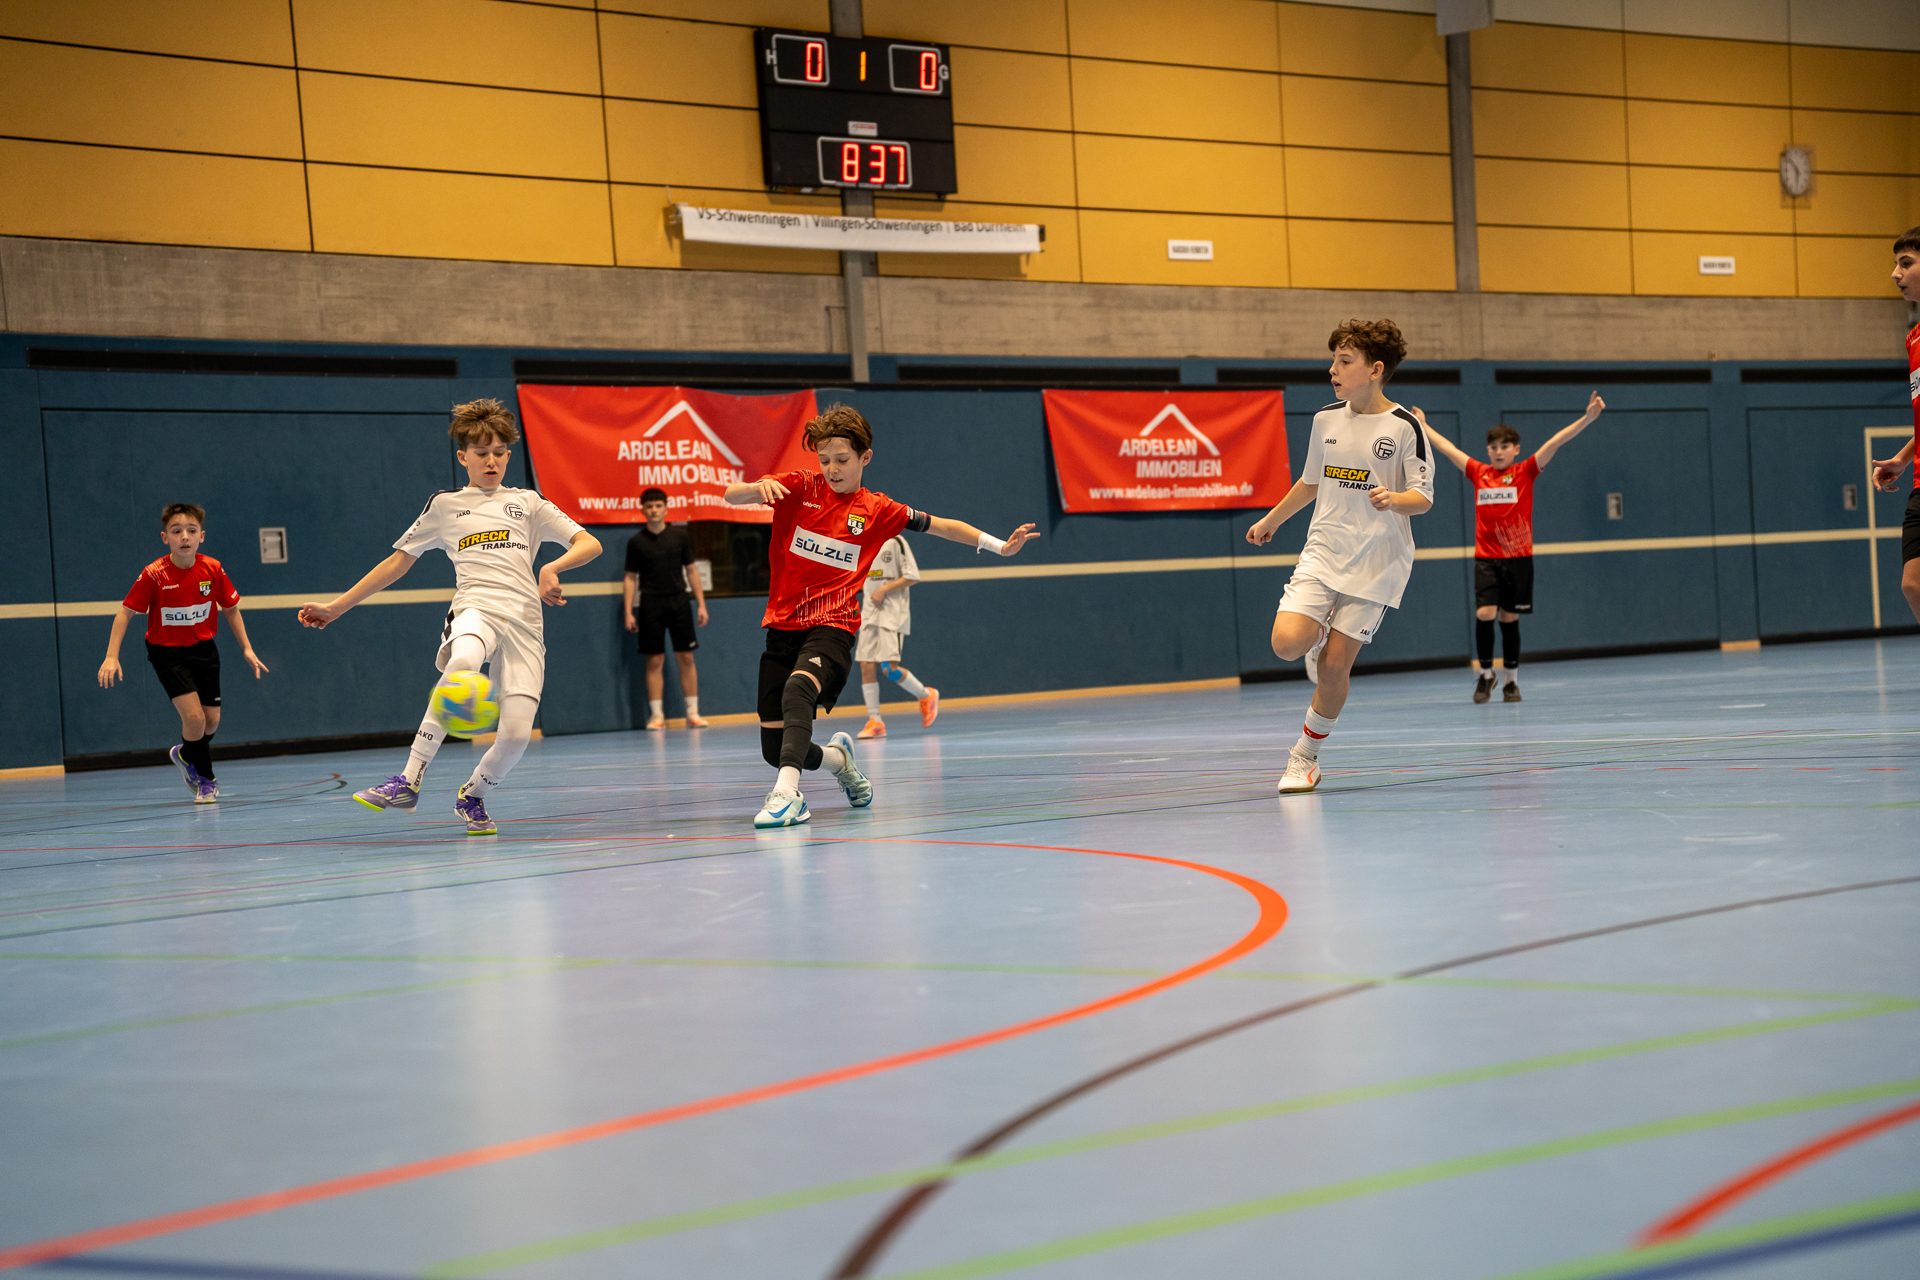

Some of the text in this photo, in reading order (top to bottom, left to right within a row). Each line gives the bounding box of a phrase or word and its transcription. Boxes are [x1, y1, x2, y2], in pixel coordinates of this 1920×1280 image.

[766, 49, 777, 65] H
[806, 43, 823, 81] 0
[920, 52, 937, 90] 0
[938, 65, 949, 80] G
[617, 439, 712, 461] ARDELEAN
[1118, 438, 1198, 457] ARDELEAN
[638, 462, 744, 487] IMMOBILIEN
[1136, 459, 1222, 478] IMMOBILIEN
[1325, 466, 1368, 481] STRECK
[1089, 481, 1253, 499] www.ardelean-immobilien.de
[1338, 480, 1389, 493] TRANSP
[1480, 492, 1514, 500] SÜLZLE
[456, 510, 471, 519] JAKO
[460, 530, 509, 550] STRECK
[481, 541, 529, 552] TRANSPORT
[795, 537, 854, 563] SÜLZLE
[417, 730, 434, 741] AKO
